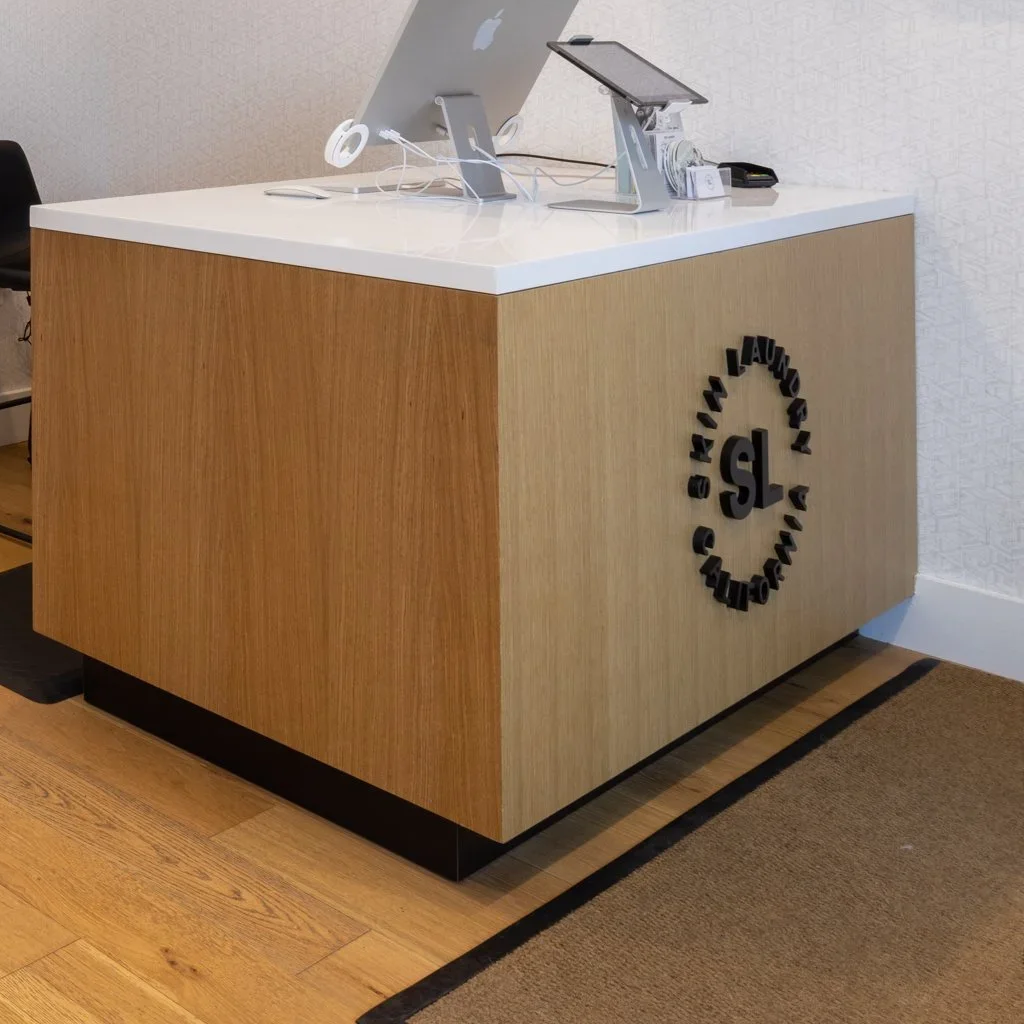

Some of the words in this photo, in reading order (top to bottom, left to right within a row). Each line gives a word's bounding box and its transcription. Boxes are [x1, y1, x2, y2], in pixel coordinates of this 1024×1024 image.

[687, 375, 728, 499] SKIN
[725, 335, 812, 455] LAUNDRY
[719, 428, 783, 520] SL
